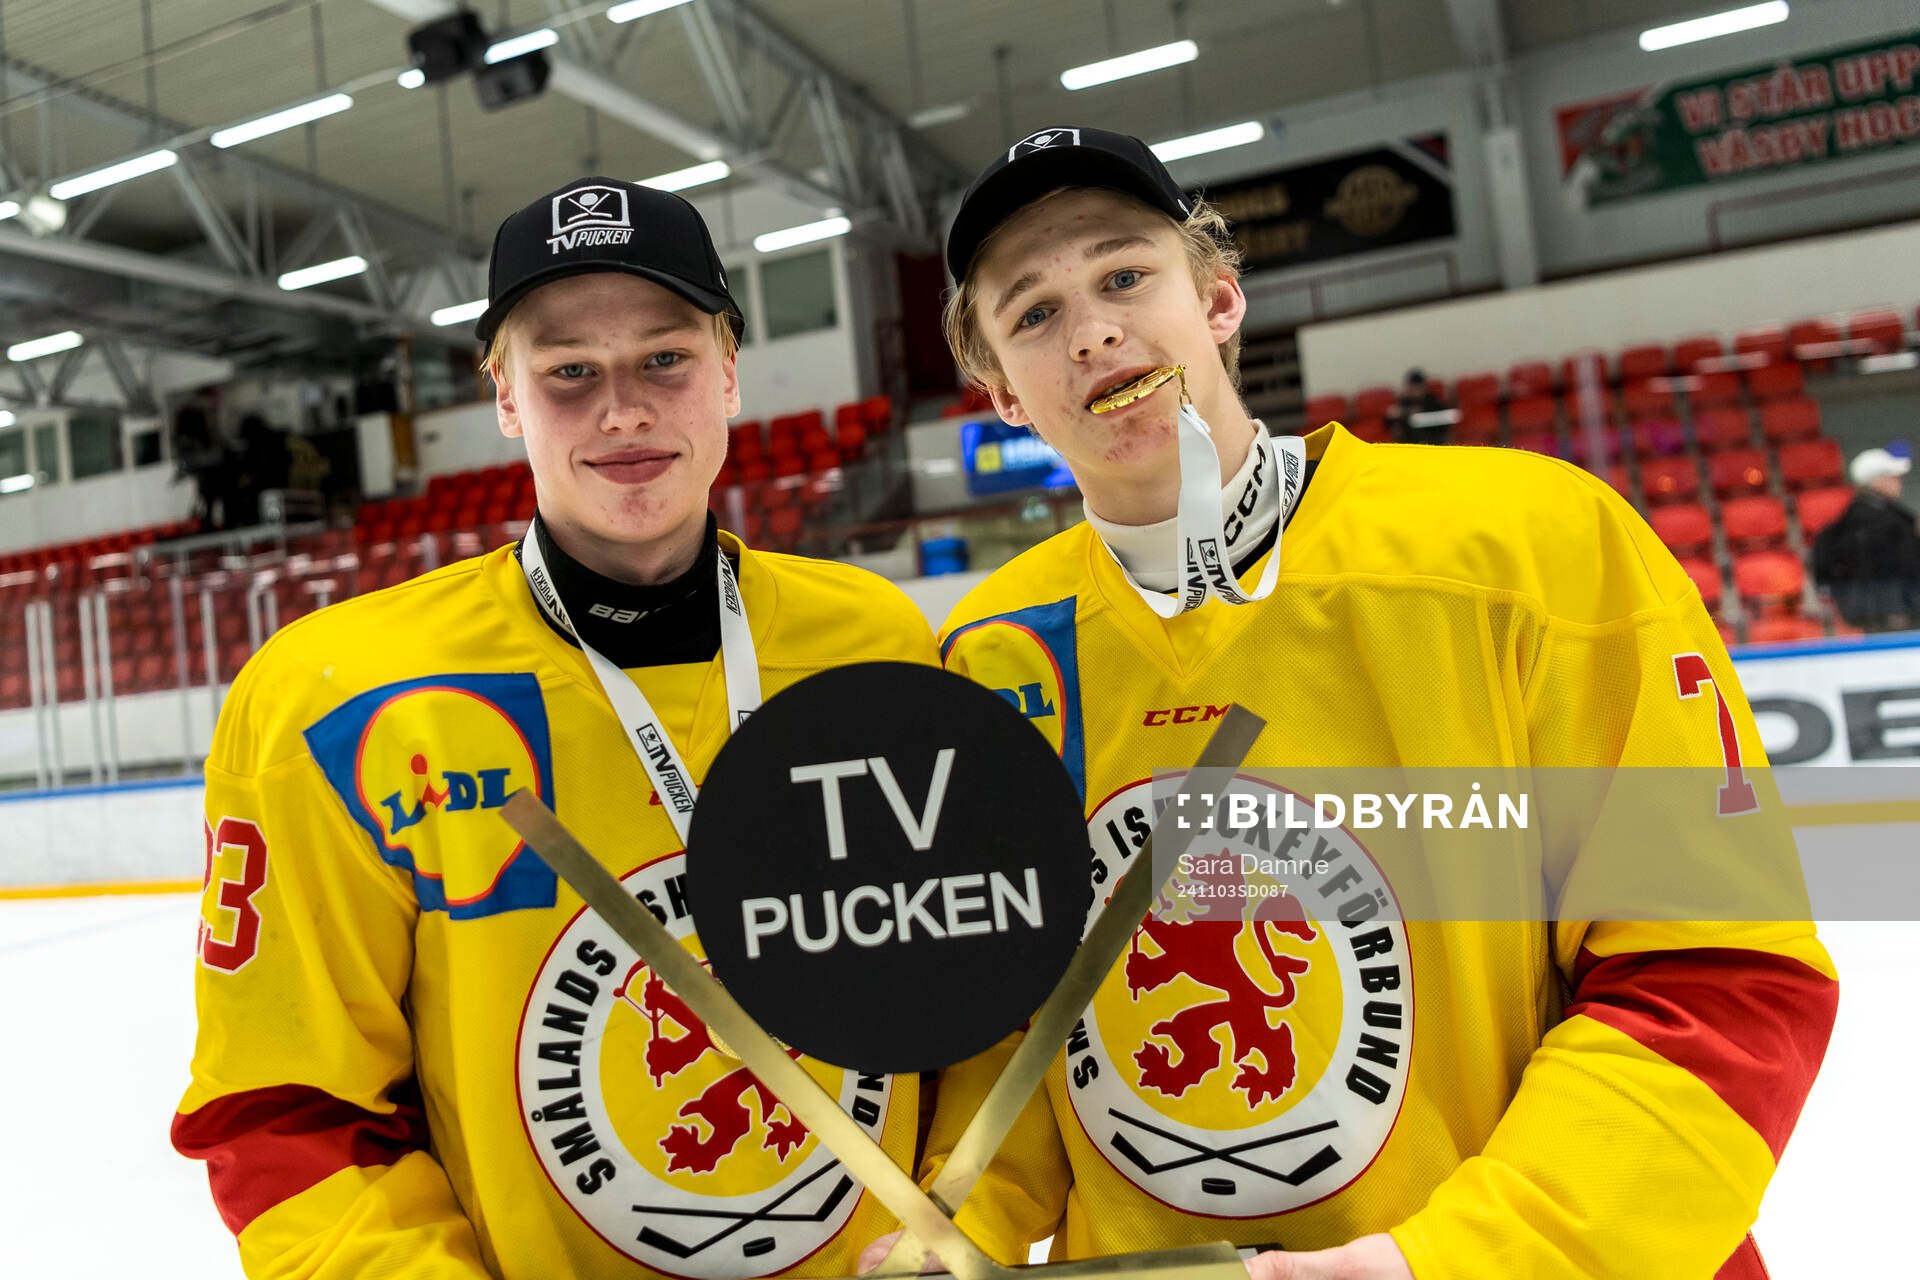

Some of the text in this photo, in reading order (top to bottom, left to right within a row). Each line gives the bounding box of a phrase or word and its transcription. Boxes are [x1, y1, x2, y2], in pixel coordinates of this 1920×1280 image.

[1726, 61, 1832, 120] STÅR
[1833, 44, 1920, 99] UPP
[1224, 443, 1266, 547] CCM
[1672, 651, 1760, 817] 7
[790, 748, 956, 860] TV
[196, 814, 268, 976] 3
[741, 867, 1044, 959] PUCKEN
[531, 938, 617, 1195] SMÅLANDS
